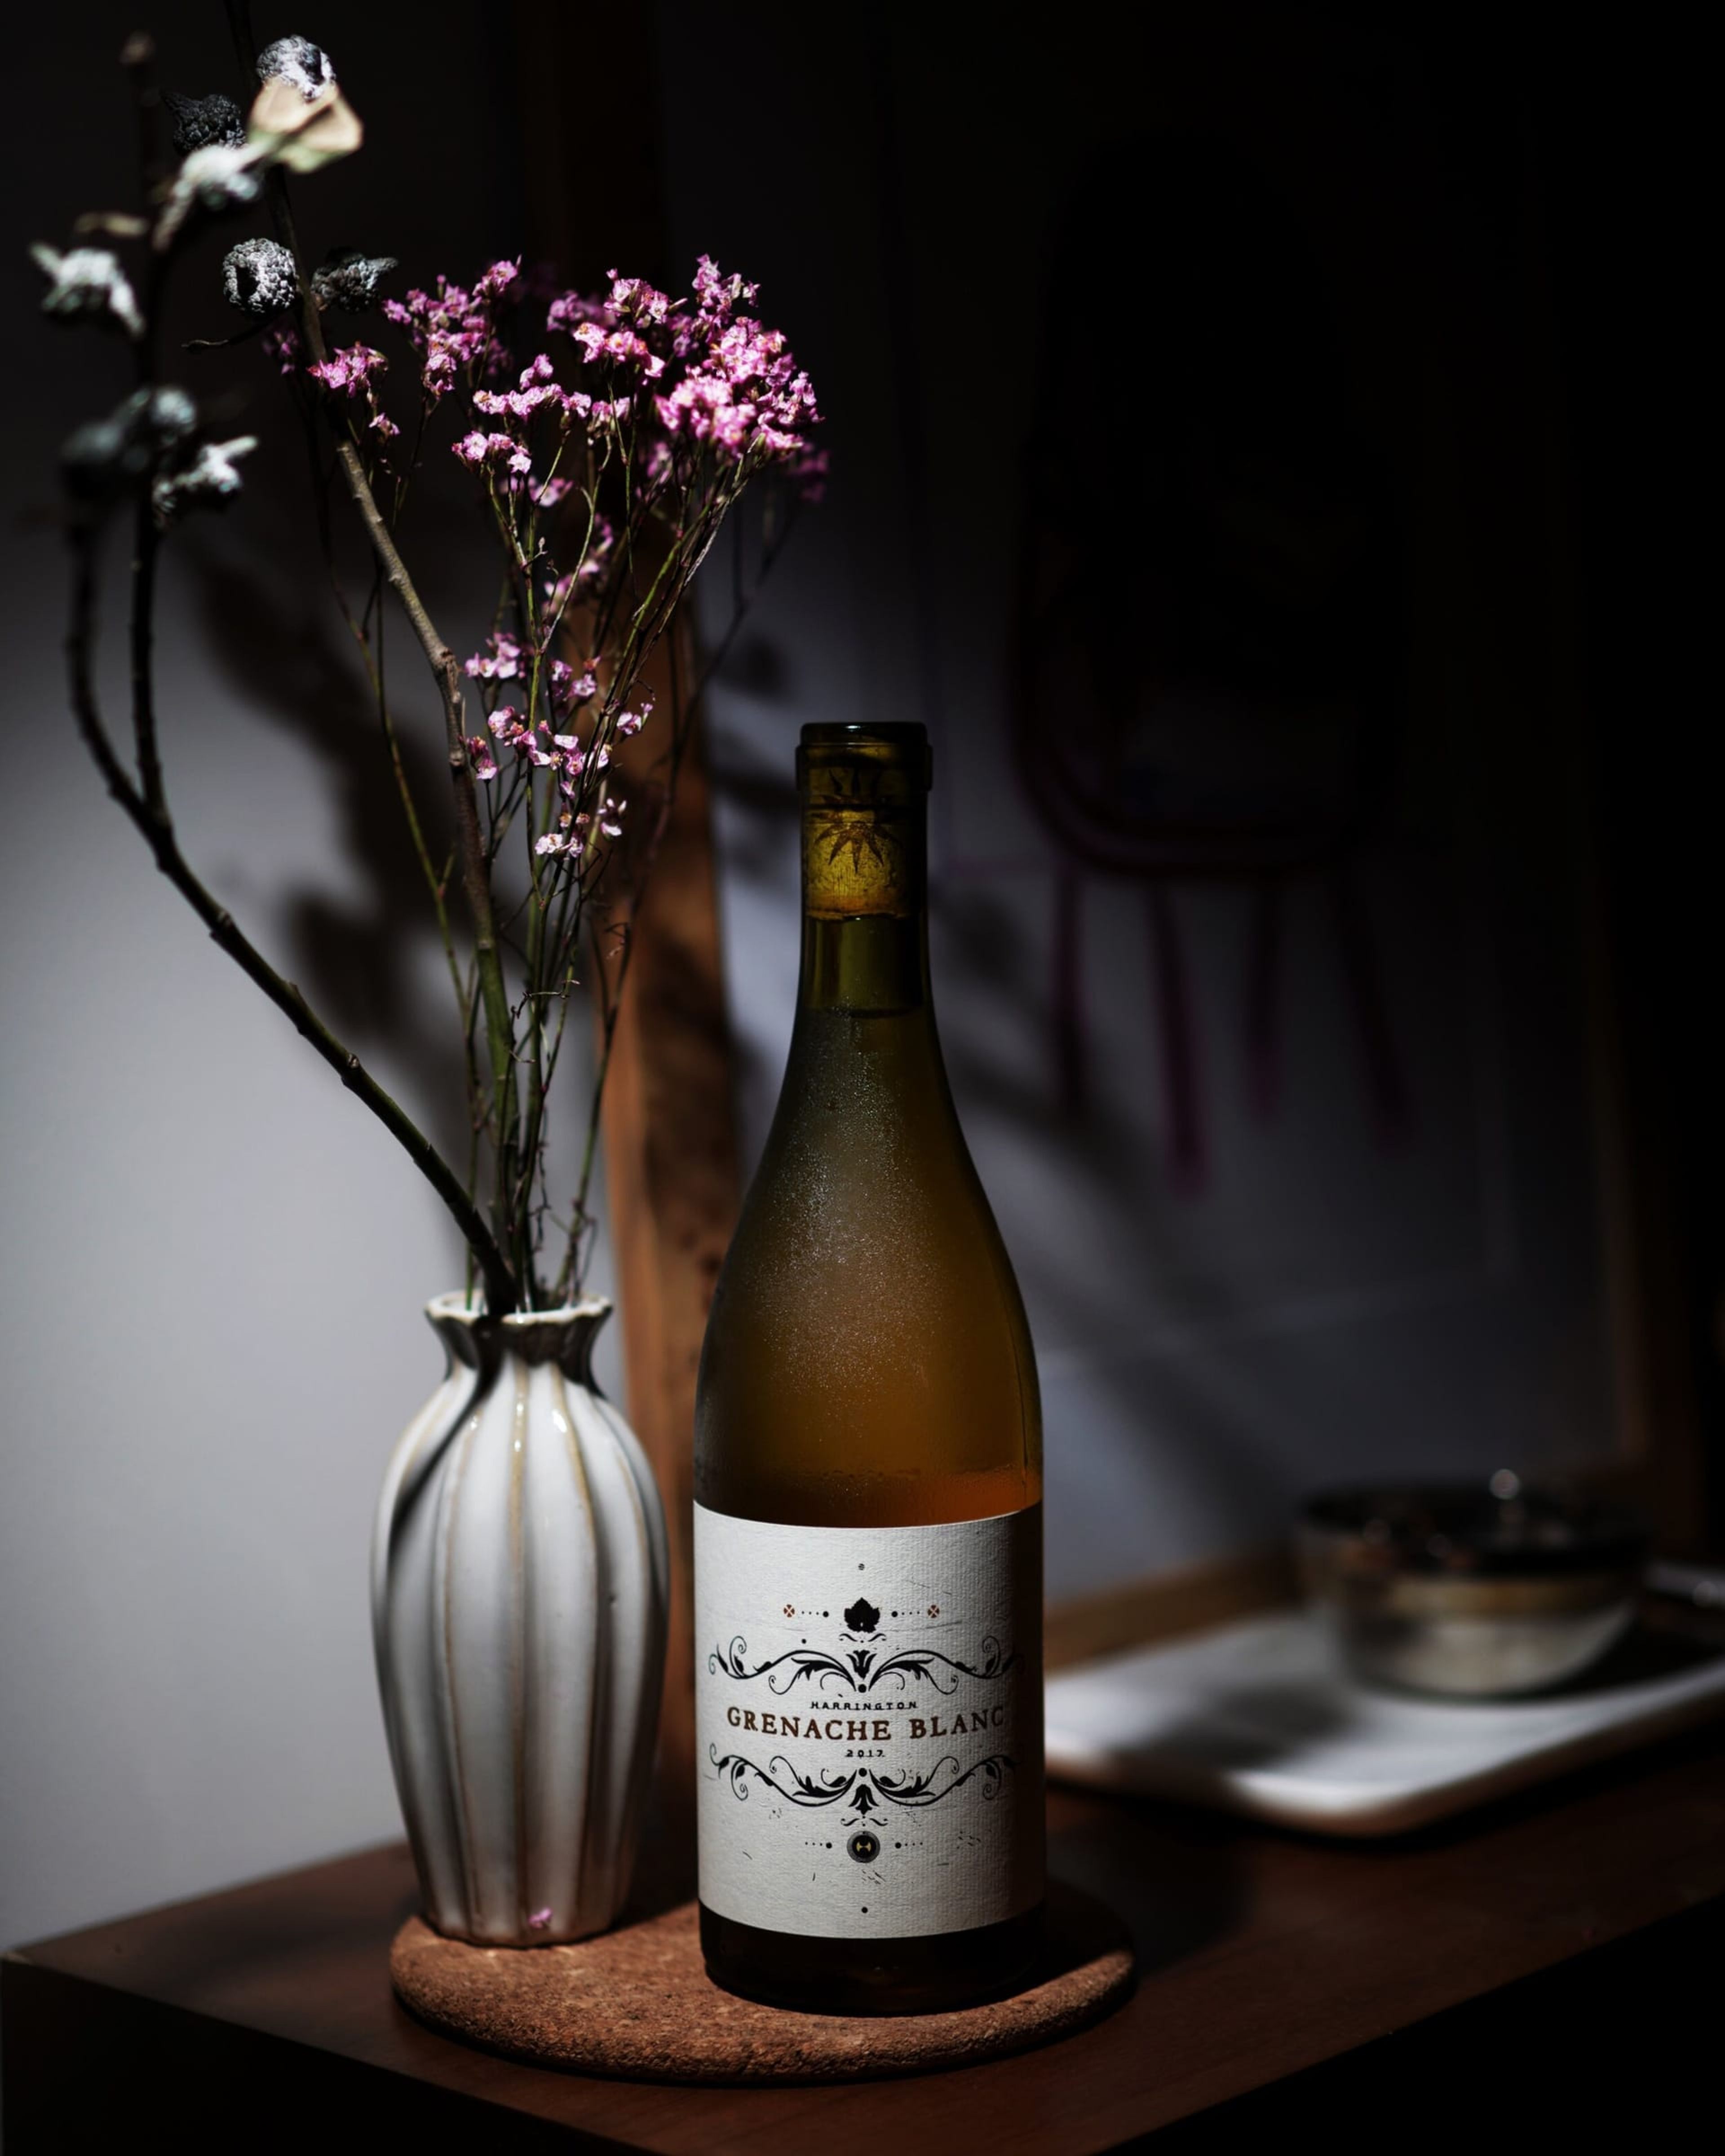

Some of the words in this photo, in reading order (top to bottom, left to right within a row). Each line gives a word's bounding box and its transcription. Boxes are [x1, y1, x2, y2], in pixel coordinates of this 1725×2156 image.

[810, 1701, 917, 1710] HARRINGTON
[727, 1706, 891, 1741] GRENACHE
[909, 1706, 1004, 1739] BLANC
